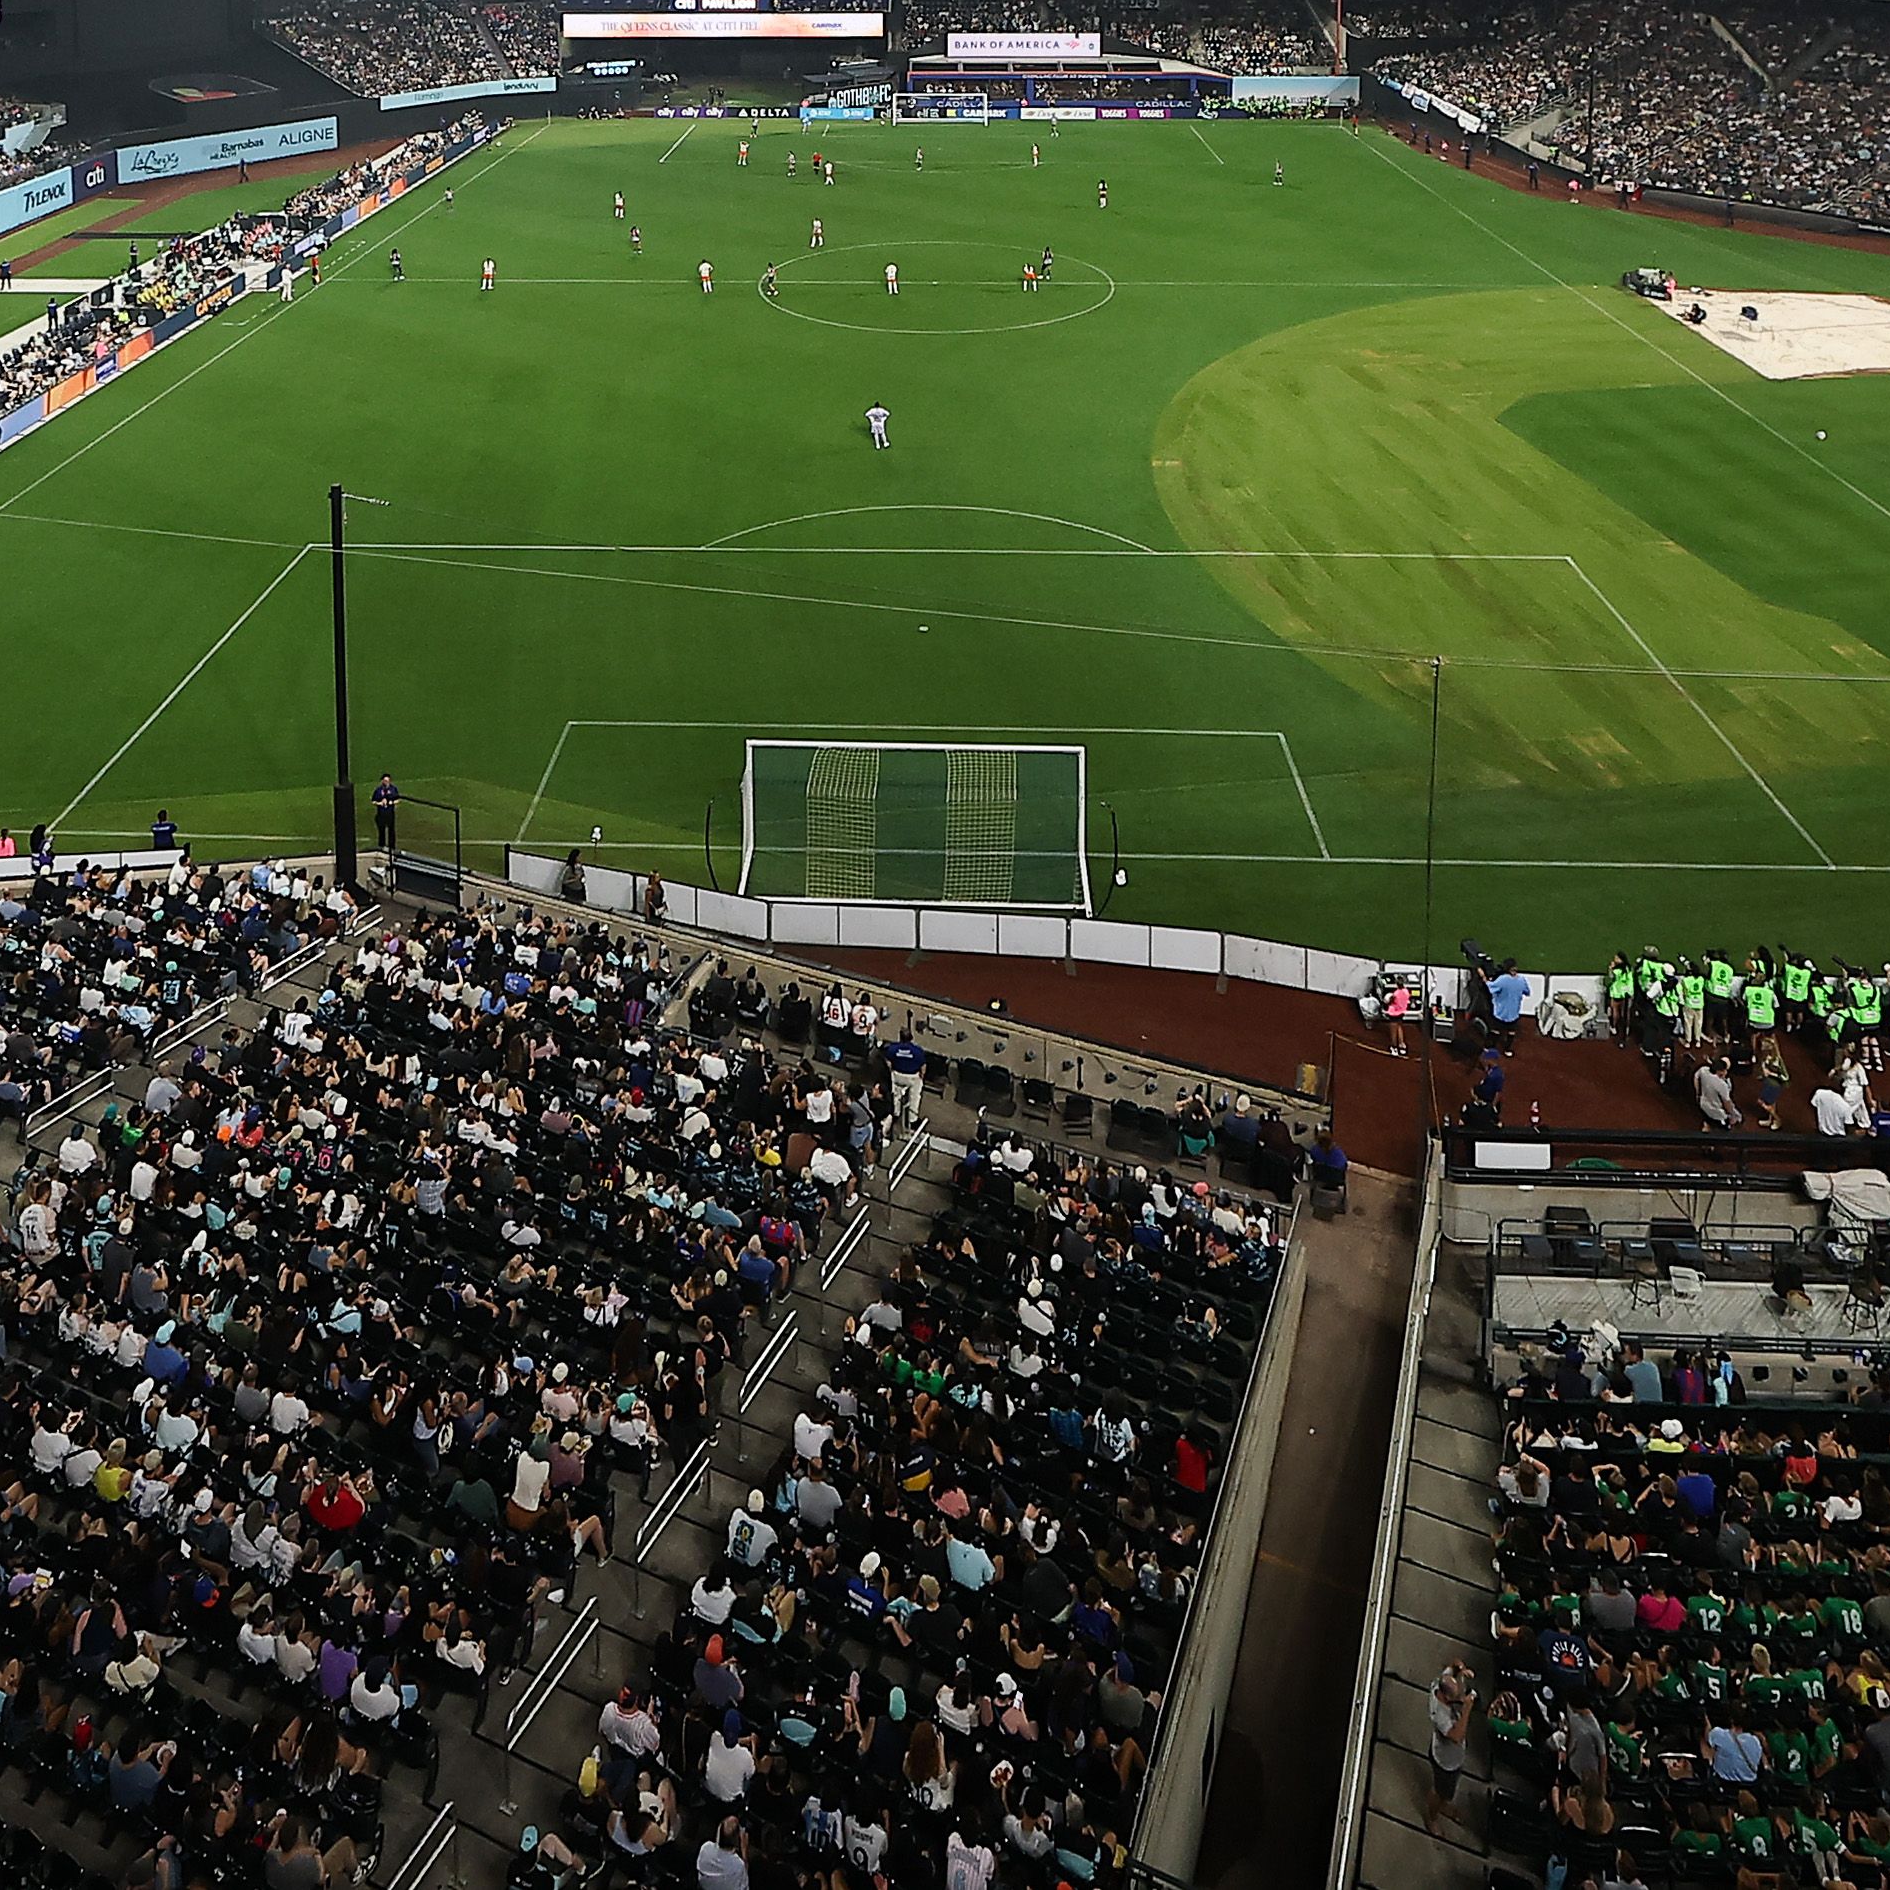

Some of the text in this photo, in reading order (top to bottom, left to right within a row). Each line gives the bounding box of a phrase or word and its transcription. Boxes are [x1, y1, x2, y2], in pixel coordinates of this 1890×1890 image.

[601, 21, 618, 32] THE
[620, 21, 657, 34] QUEENS
[659, 20, 695, 32] CLASSIC
[954, 40, 1061, 50] BANK OF AMERICA
[879, 83, 892, 103] FC
[750, 108, 789, 118] DELTA
[1135, 100, 1192, 108] CADILLAC
[221, 138, 264, 153] Barnabas
[278, 127, 334, 147] ALIGNE
[86, 161, 105, 188] citi
[1697, 1606, 1722, 1634] 12
[1840, 1608, 1864, 1635] 18
[1708, 1676, 1721, 1700] 5
[1787, 1748, 1802, 1771] 2
